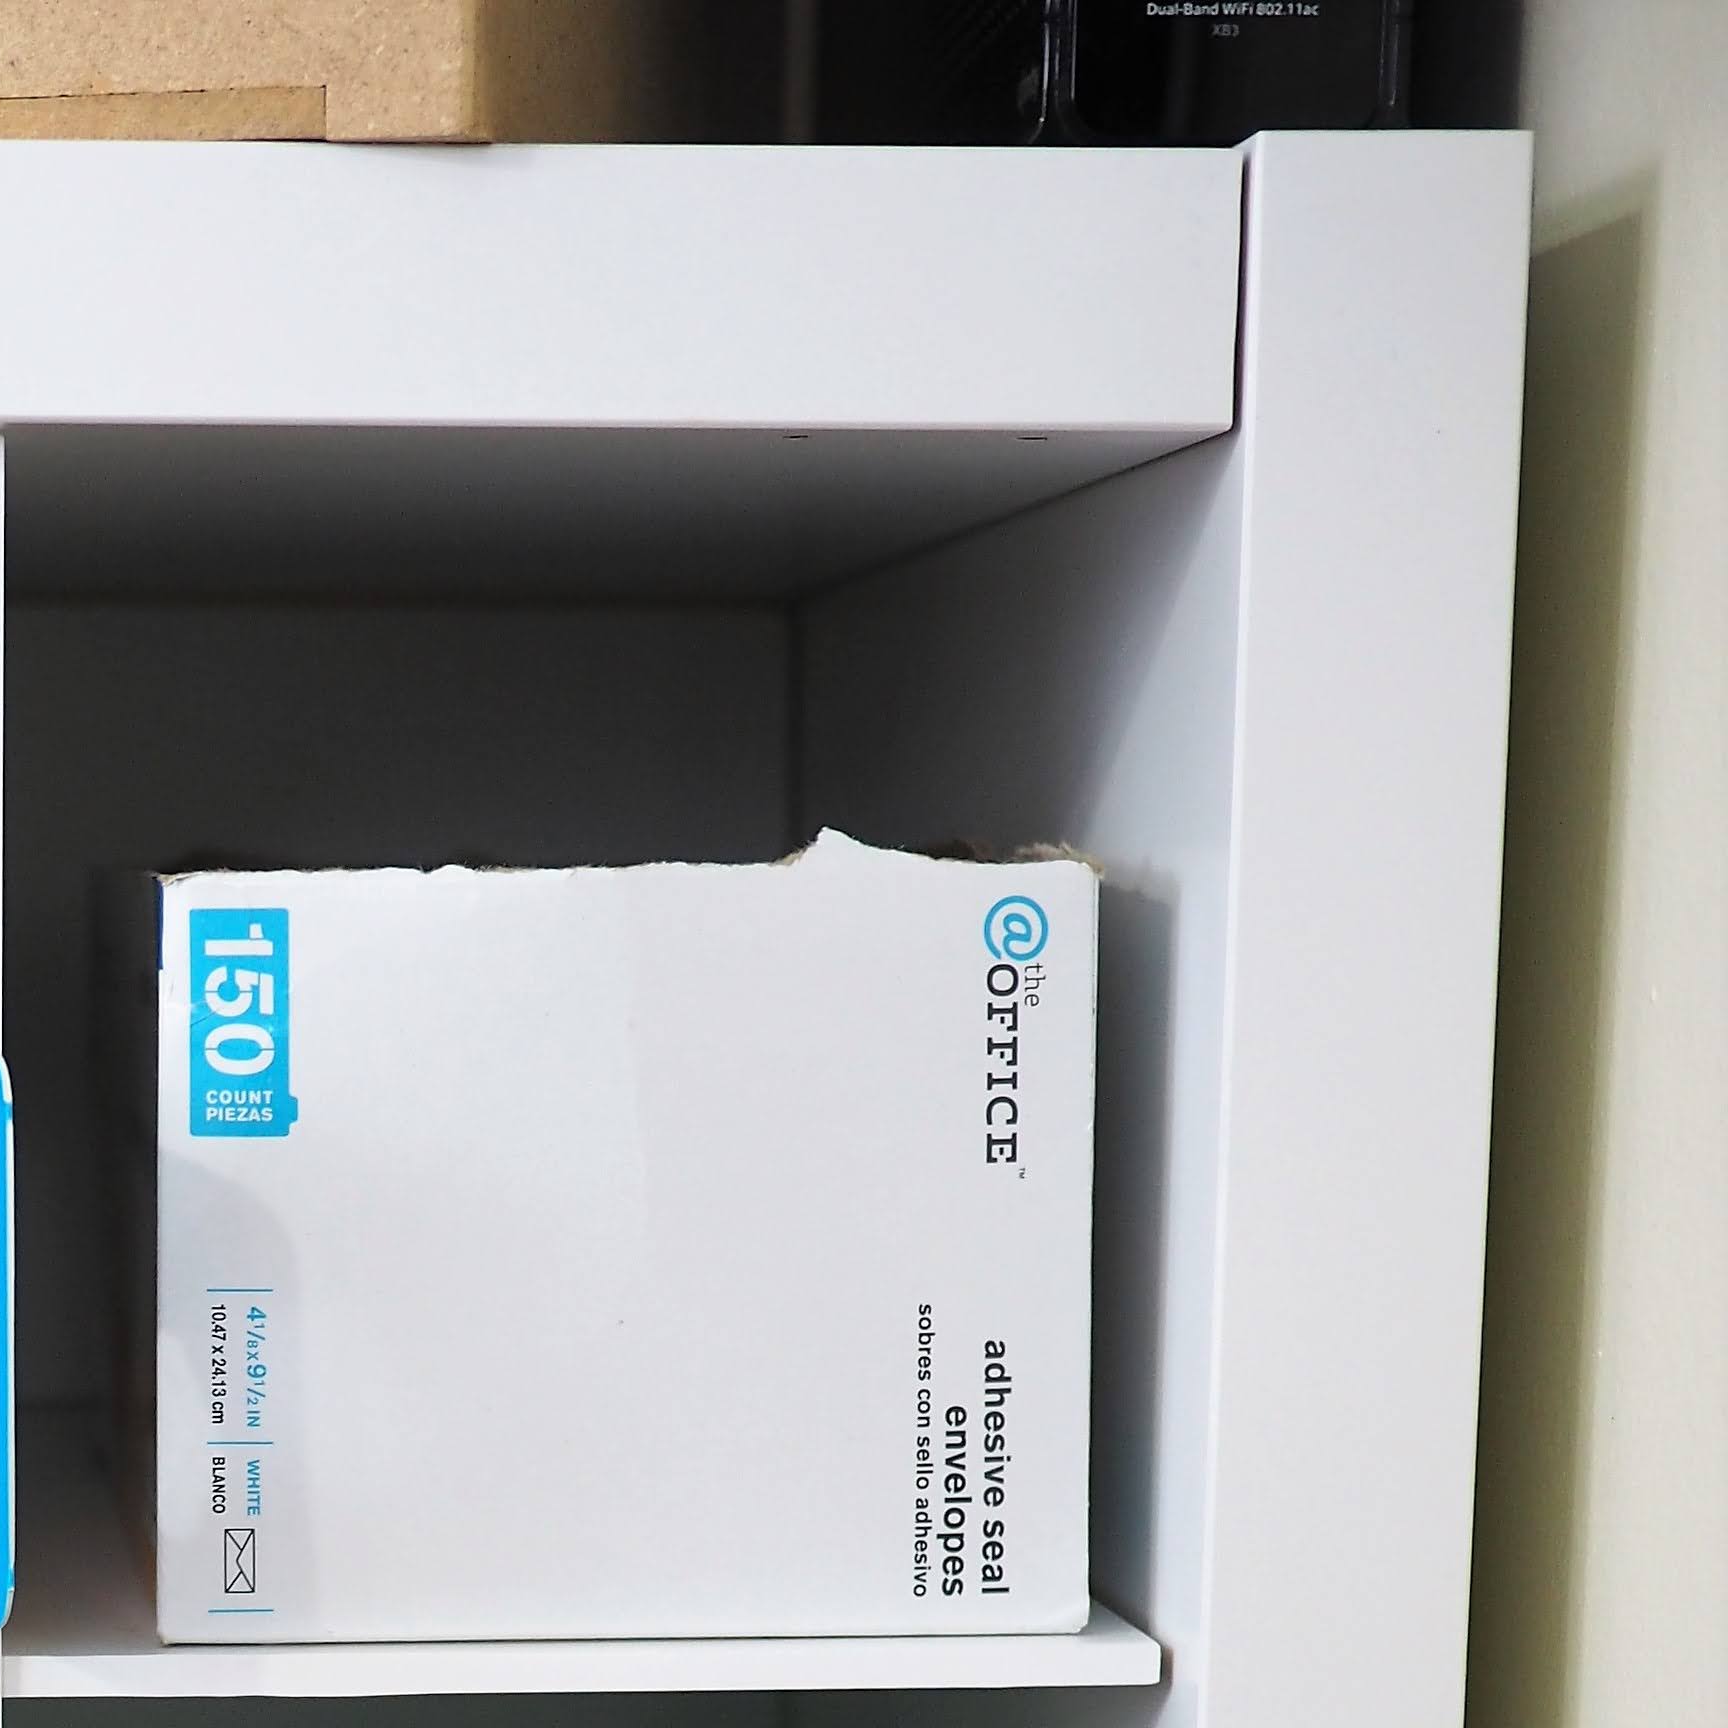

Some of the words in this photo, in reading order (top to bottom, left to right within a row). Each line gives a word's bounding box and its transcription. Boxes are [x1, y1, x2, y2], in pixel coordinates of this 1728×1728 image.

[1146, 2, 1219, 16] Dual-Band
[1223, 2, 1254, 16] WiFi
[1256, 2, 1320, 16] 802.11ac
[205, 923, 275, 1076] 150
[1024, 962, 1047, 1008] the
[985, 963, 1020, 1164] OFFICE
[206, 1090, 273, 1105] COUNT
[206, 1106, 274, 1122] PIEZAS
[211, 1304, 227, 1341] 10.47
[917, 1304, 935, 1381] sobres
[211, 1345, 224, 1354] x
[211, 1358, 227, 1398] 24.13
[211, 1401, 224, 1424] cm
[247, 1410, 260, 1427] IN
[917, 1388, 931, 1428] con
[983, 1340, 1012, 1507] adhesive
[212, 1457, 226, 1514] BLANCO
[247, 1459, 260, 1516] WHITE
[916, 1436, 933, 1490] sello
[937, 1405, 972, 1596] envelopes
[913, 1498, 933, 1597] adhesivo
[982, 1519, 1009, 1594] seal
